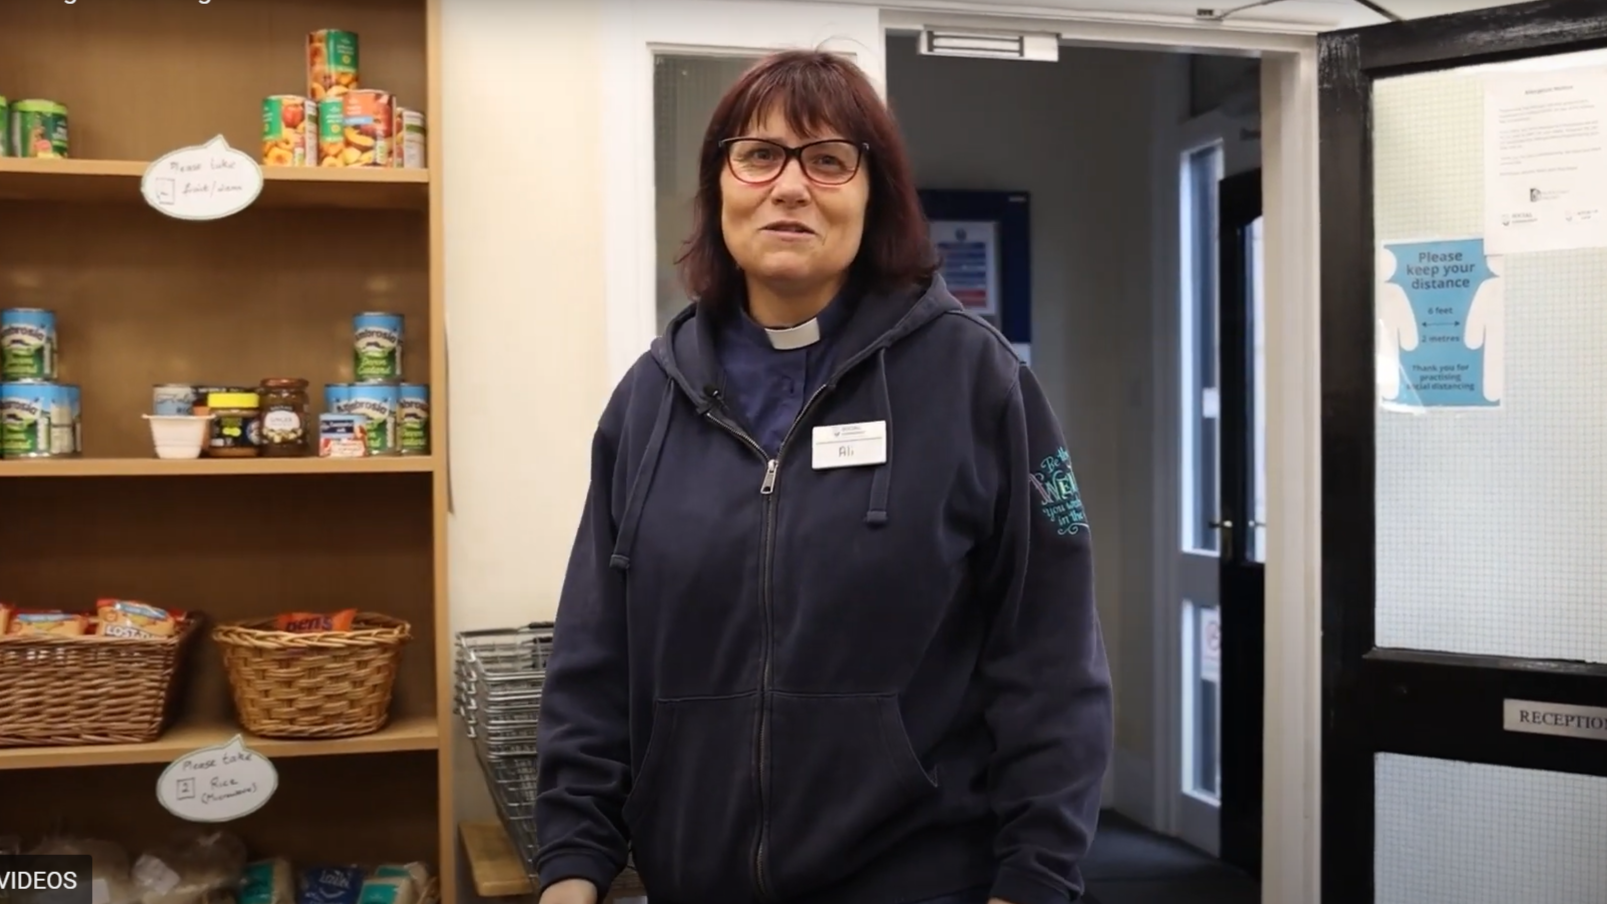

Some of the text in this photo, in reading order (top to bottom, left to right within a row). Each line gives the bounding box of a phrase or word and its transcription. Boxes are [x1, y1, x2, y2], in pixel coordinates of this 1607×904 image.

[1418, 251, 1463, 263] Please
[1406, 262, 1475, 278] keep your
[1411, 277, 1470, 290] distance
[1427, 306, 1453, 315] 6 feet
[1429, 334, 1460, 343] metres
[1412, 364, 1470, 373] Thank you for
[1419, 372, 1462, 383] practising
[1431, 382, 1475, 391] distancing
[838, 446, 854, 458] Ali
[1040, 456, 1060, 474] Be
[183, 751, 252, 772] Please take
[181, 776, 239, 793] 2 Rice
